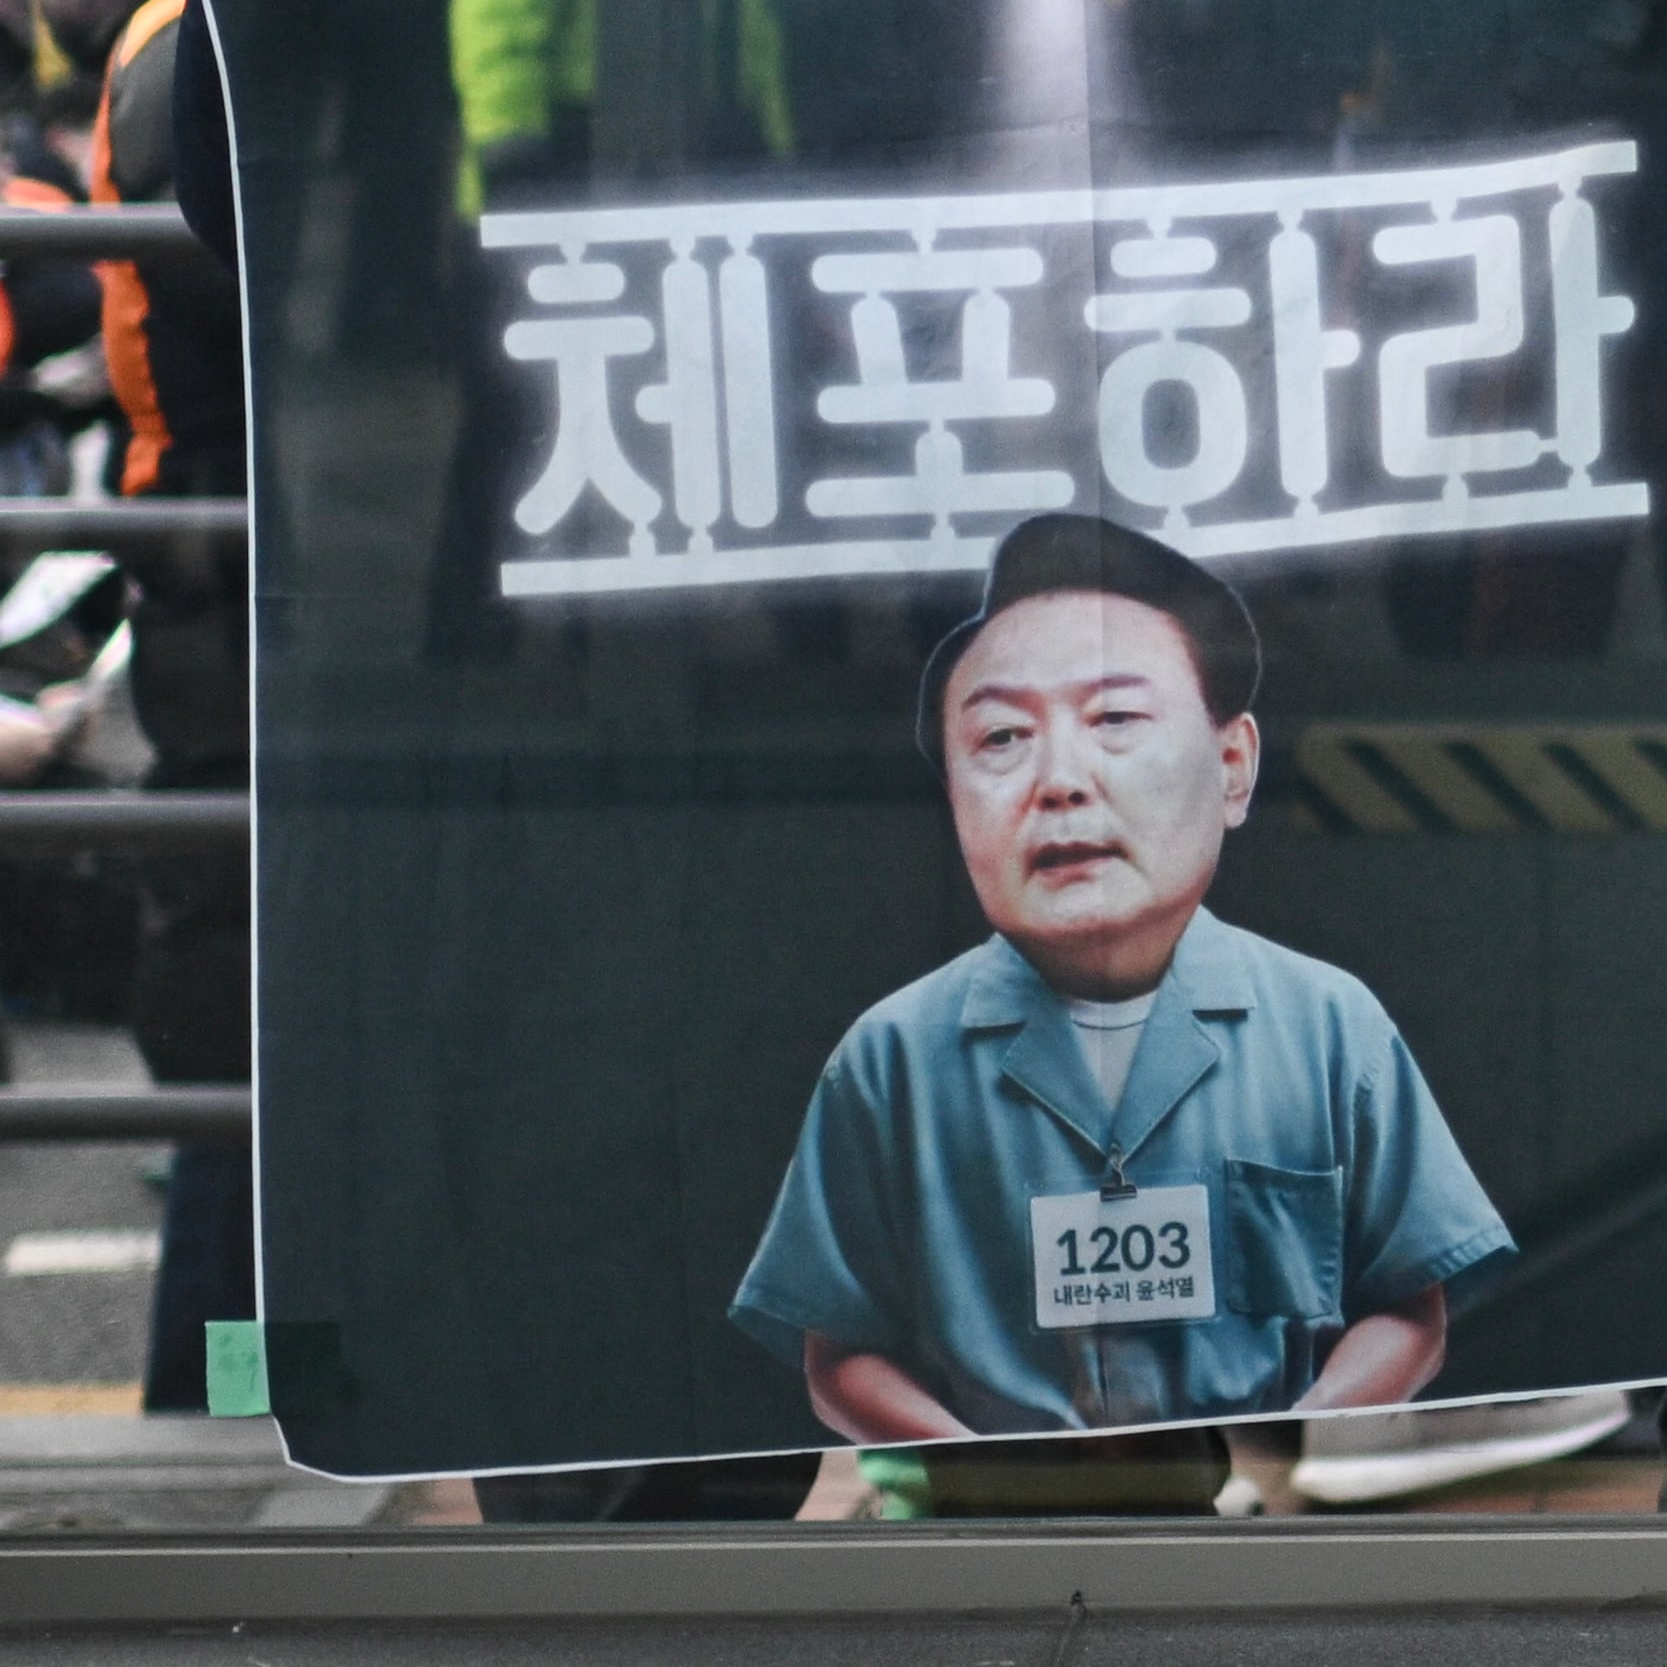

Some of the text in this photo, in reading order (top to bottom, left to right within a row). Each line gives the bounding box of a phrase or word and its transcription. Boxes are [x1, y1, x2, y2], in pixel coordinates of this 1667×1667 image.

[490, 159, 1645, 559] 체포하라
[1056, 1221, 1191, 1276] 1203
[1054, 1277, 1195, 1306] 내란수괴 윤석열
